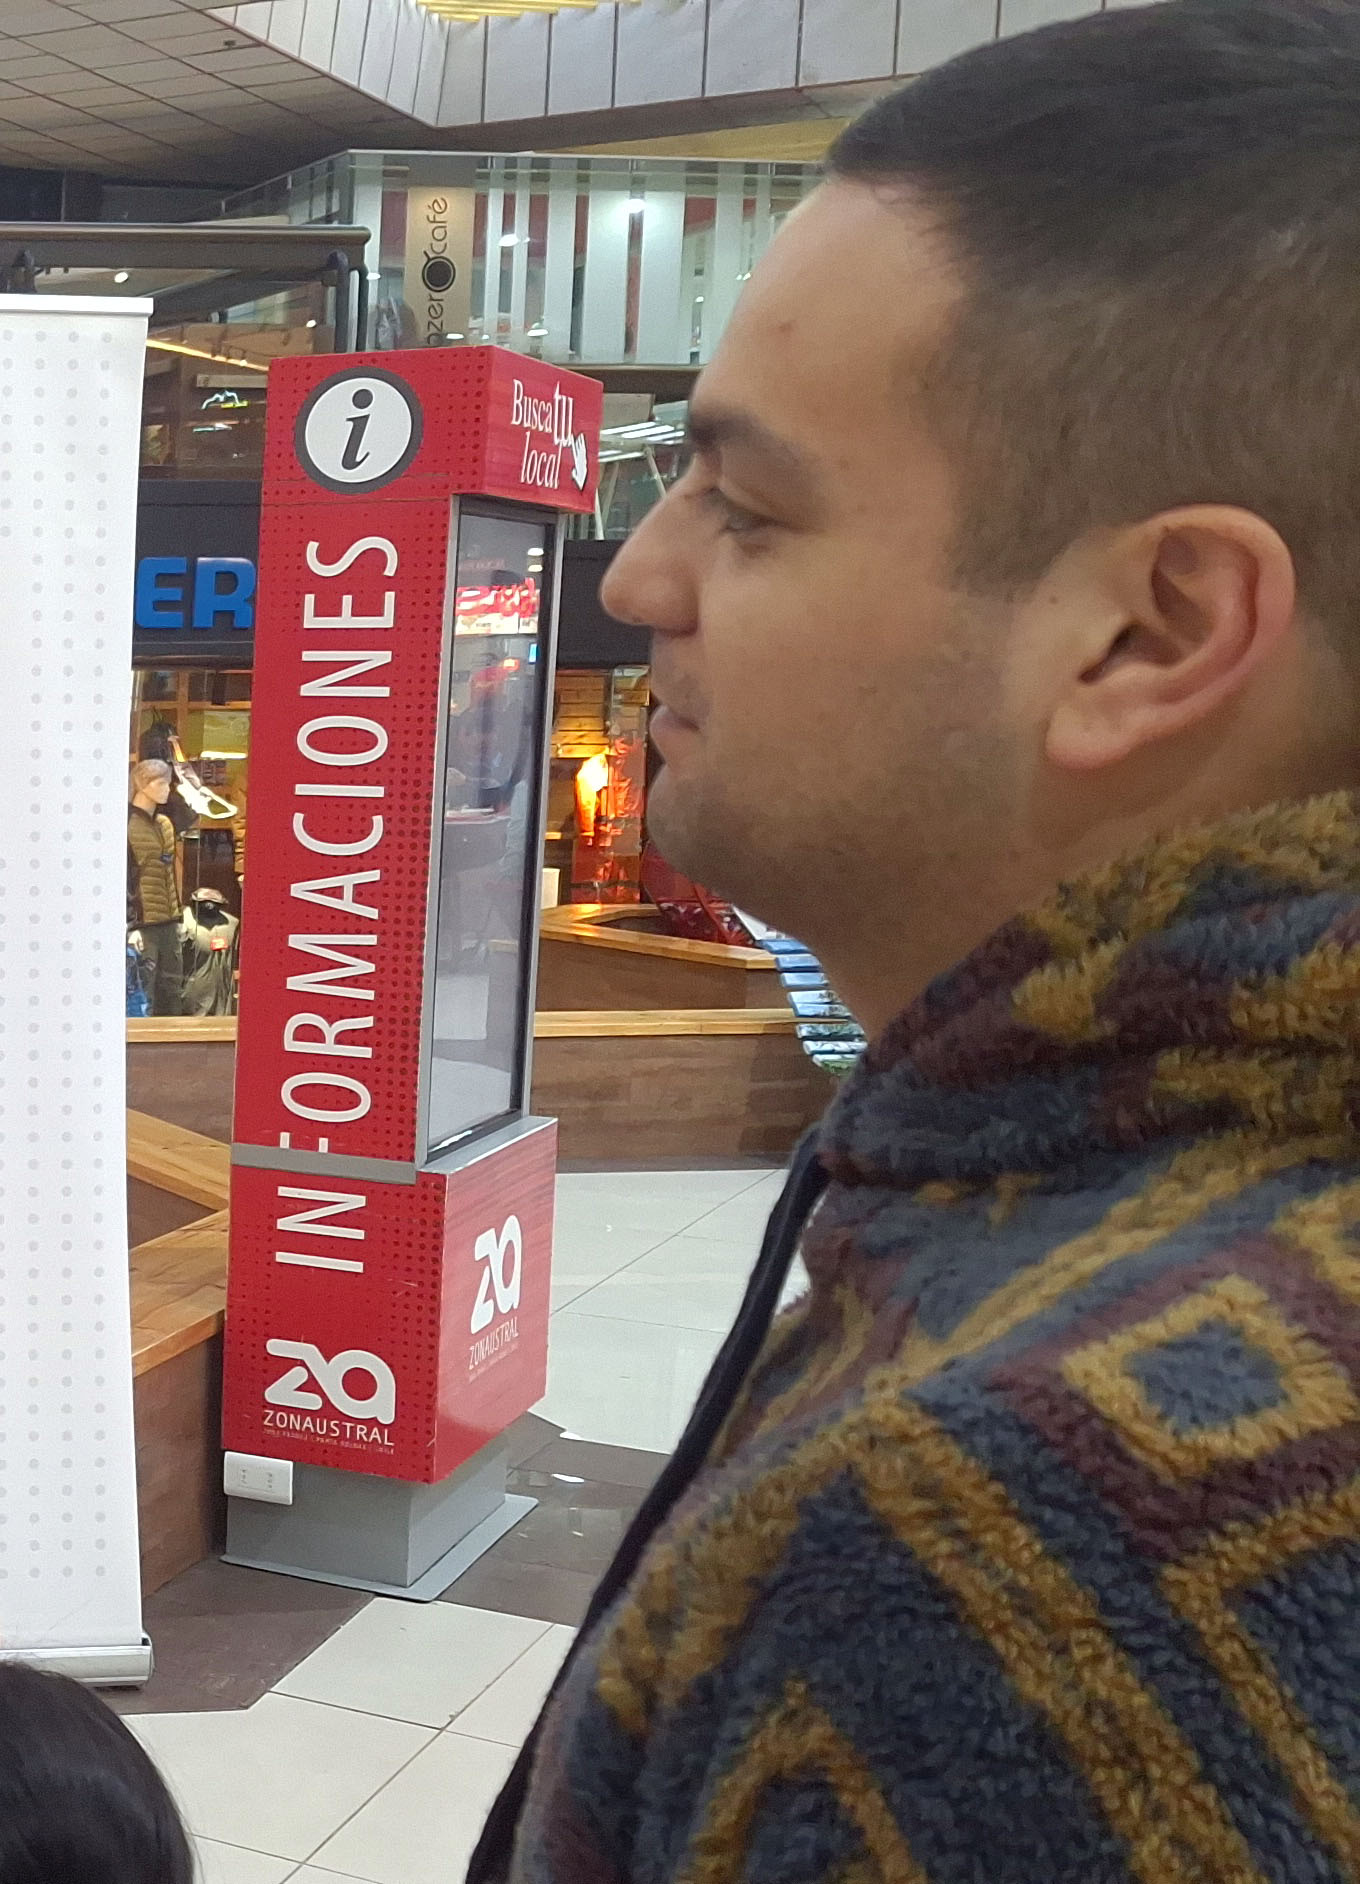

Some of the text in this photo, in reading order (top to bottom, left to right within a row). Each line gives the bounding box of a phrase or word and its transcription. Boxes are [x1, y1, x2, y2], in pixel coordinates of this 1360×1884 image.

[510, 378, 574, 448] Busca tu
[519, 431, 563, 490] local
[468, 1316, 519, 1371] ZONAUSTRAL
[262, 1409, 396, 1446] ZONAUSTRAL
